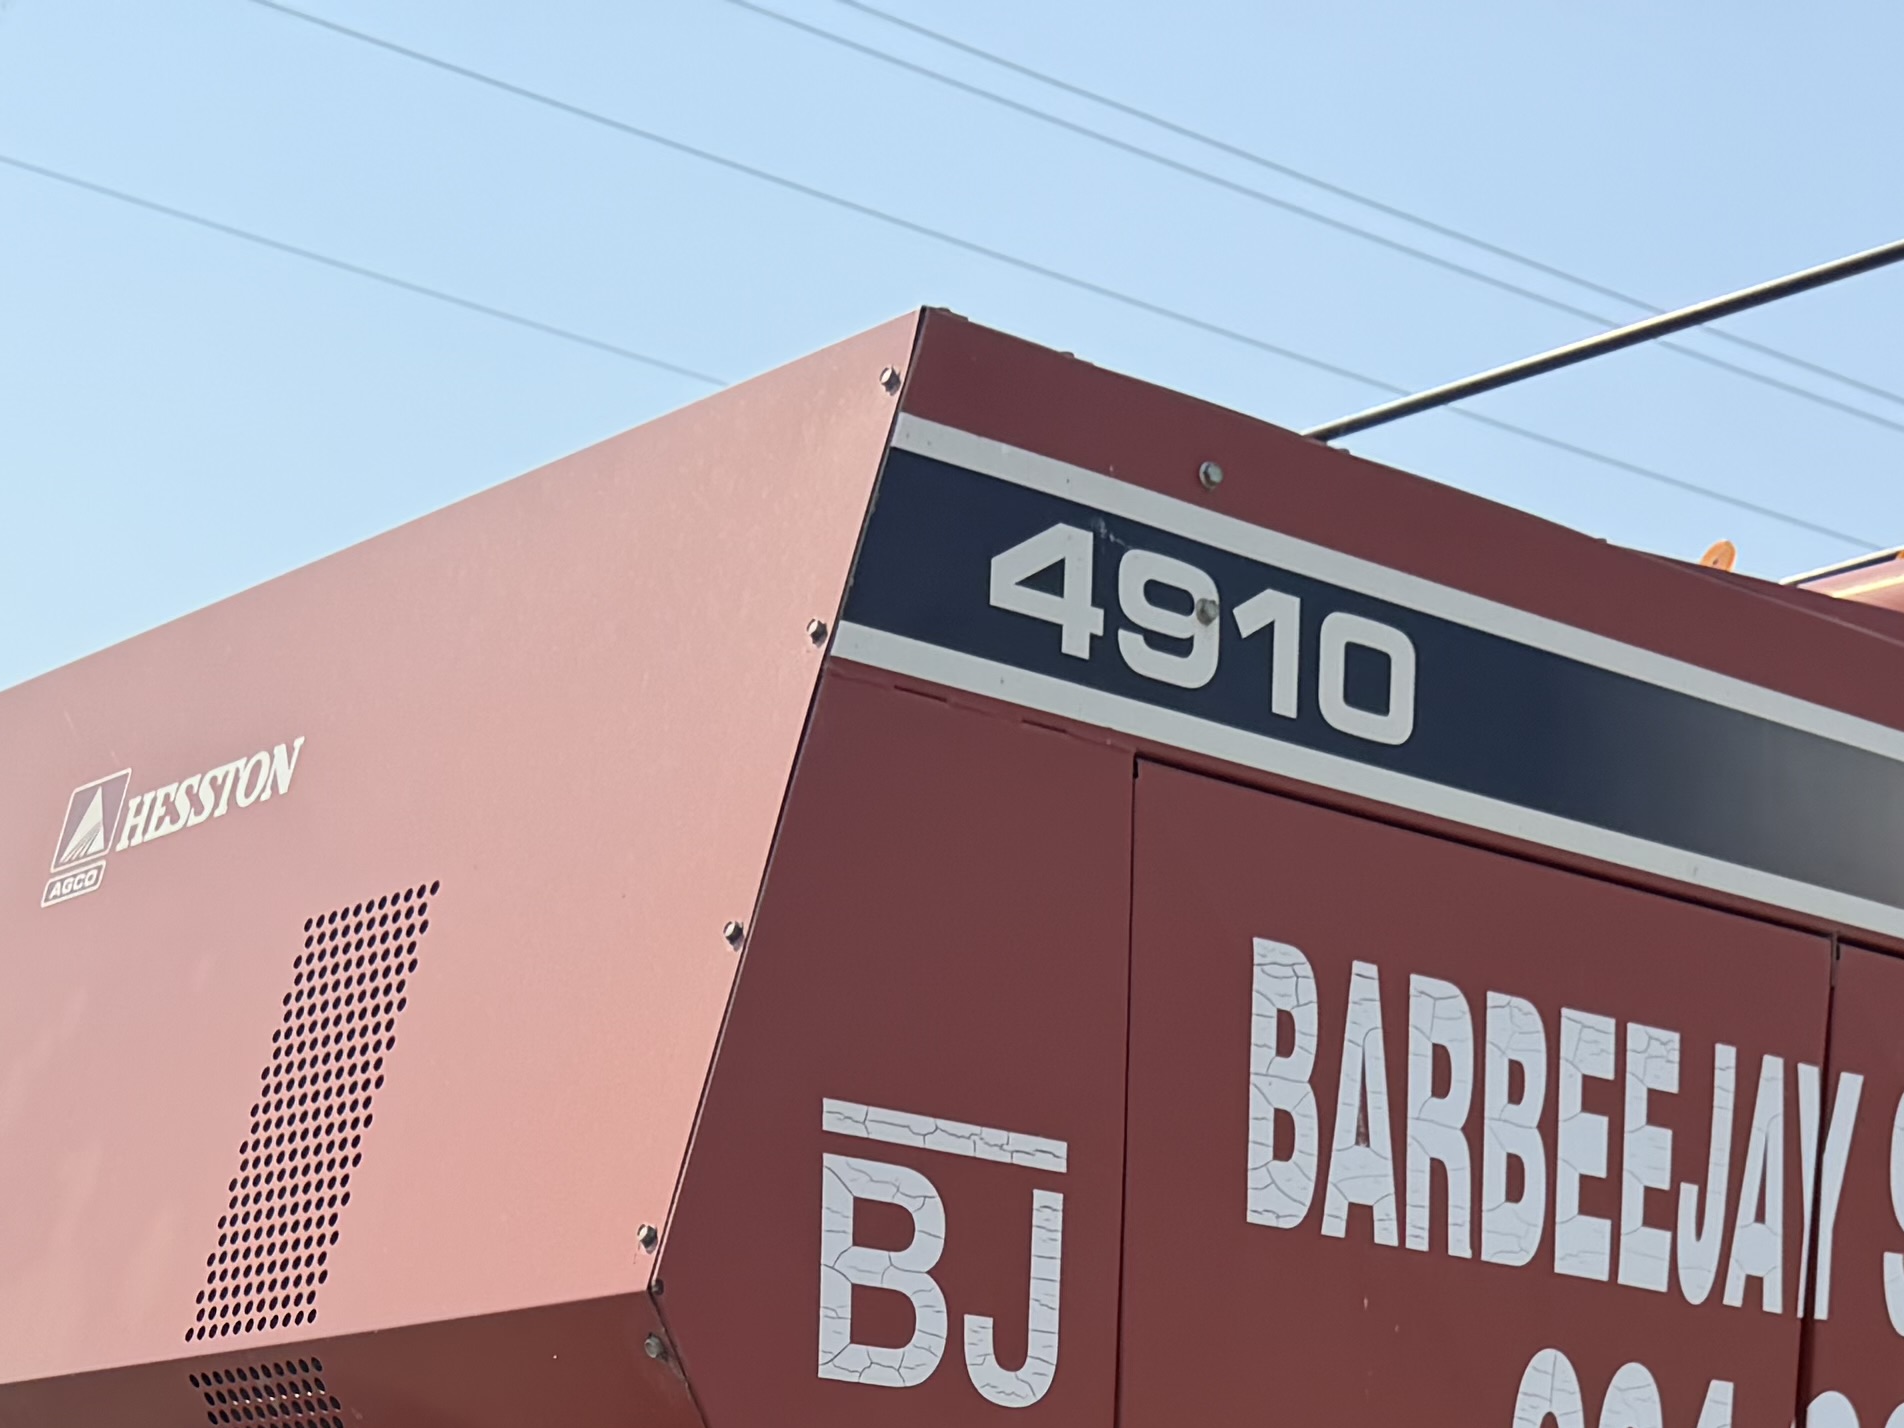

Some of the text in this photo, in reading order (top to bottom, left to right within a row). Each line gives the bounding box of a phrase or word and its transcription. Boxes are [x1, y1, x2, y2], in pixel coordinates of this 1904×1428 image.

[988, 521, 1417, 746] 4910
[48, 868, 98, 900] AGCO
[114, 735, 306, 852] HESSTON
[1246, 936, 1865, 1321] BARBEEJAY
[817, 1152, 1064, 1409] BJ
